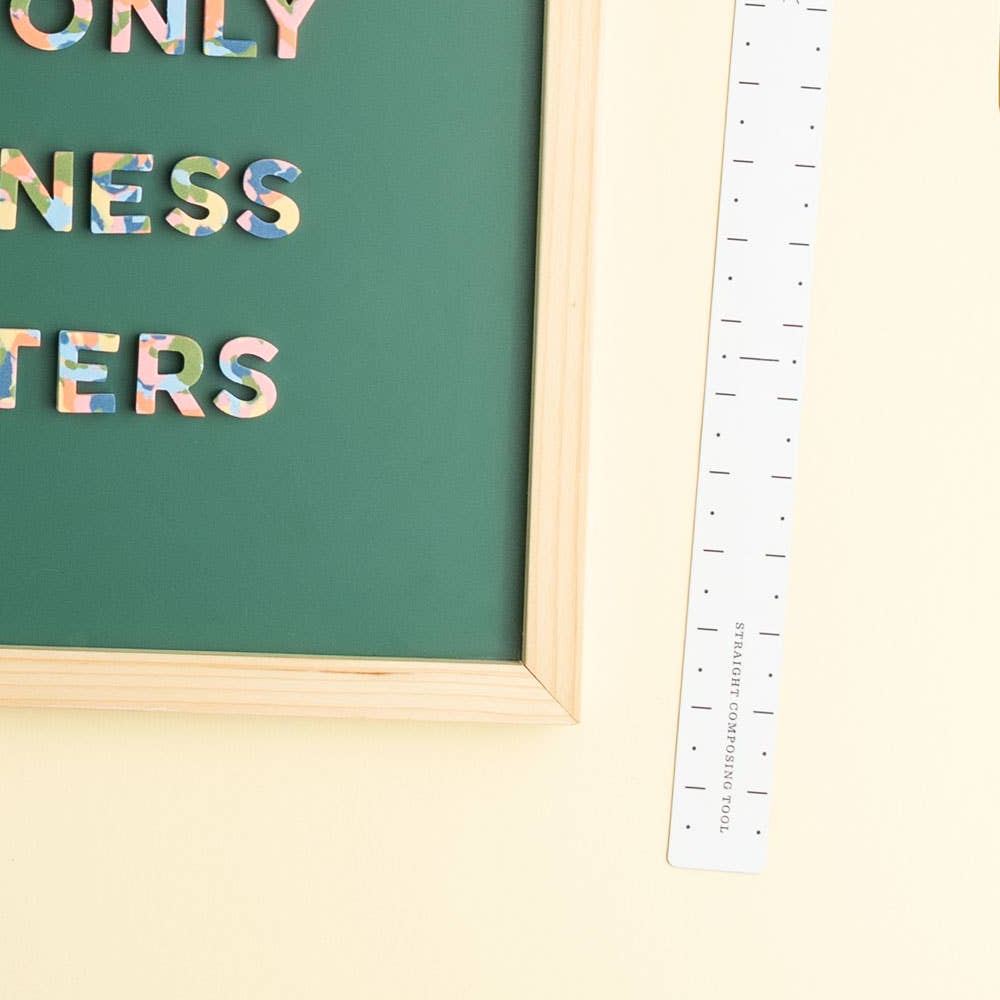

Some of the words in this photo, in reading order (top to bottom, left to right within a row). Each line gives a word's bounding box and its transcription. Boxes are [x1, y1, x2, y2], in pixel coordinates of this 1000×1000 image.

[730, 622, 745, 697] STRAIGHT
[723, 702, 739, 790] COMPOSING
[720, 796, 732, 834] TOOL
